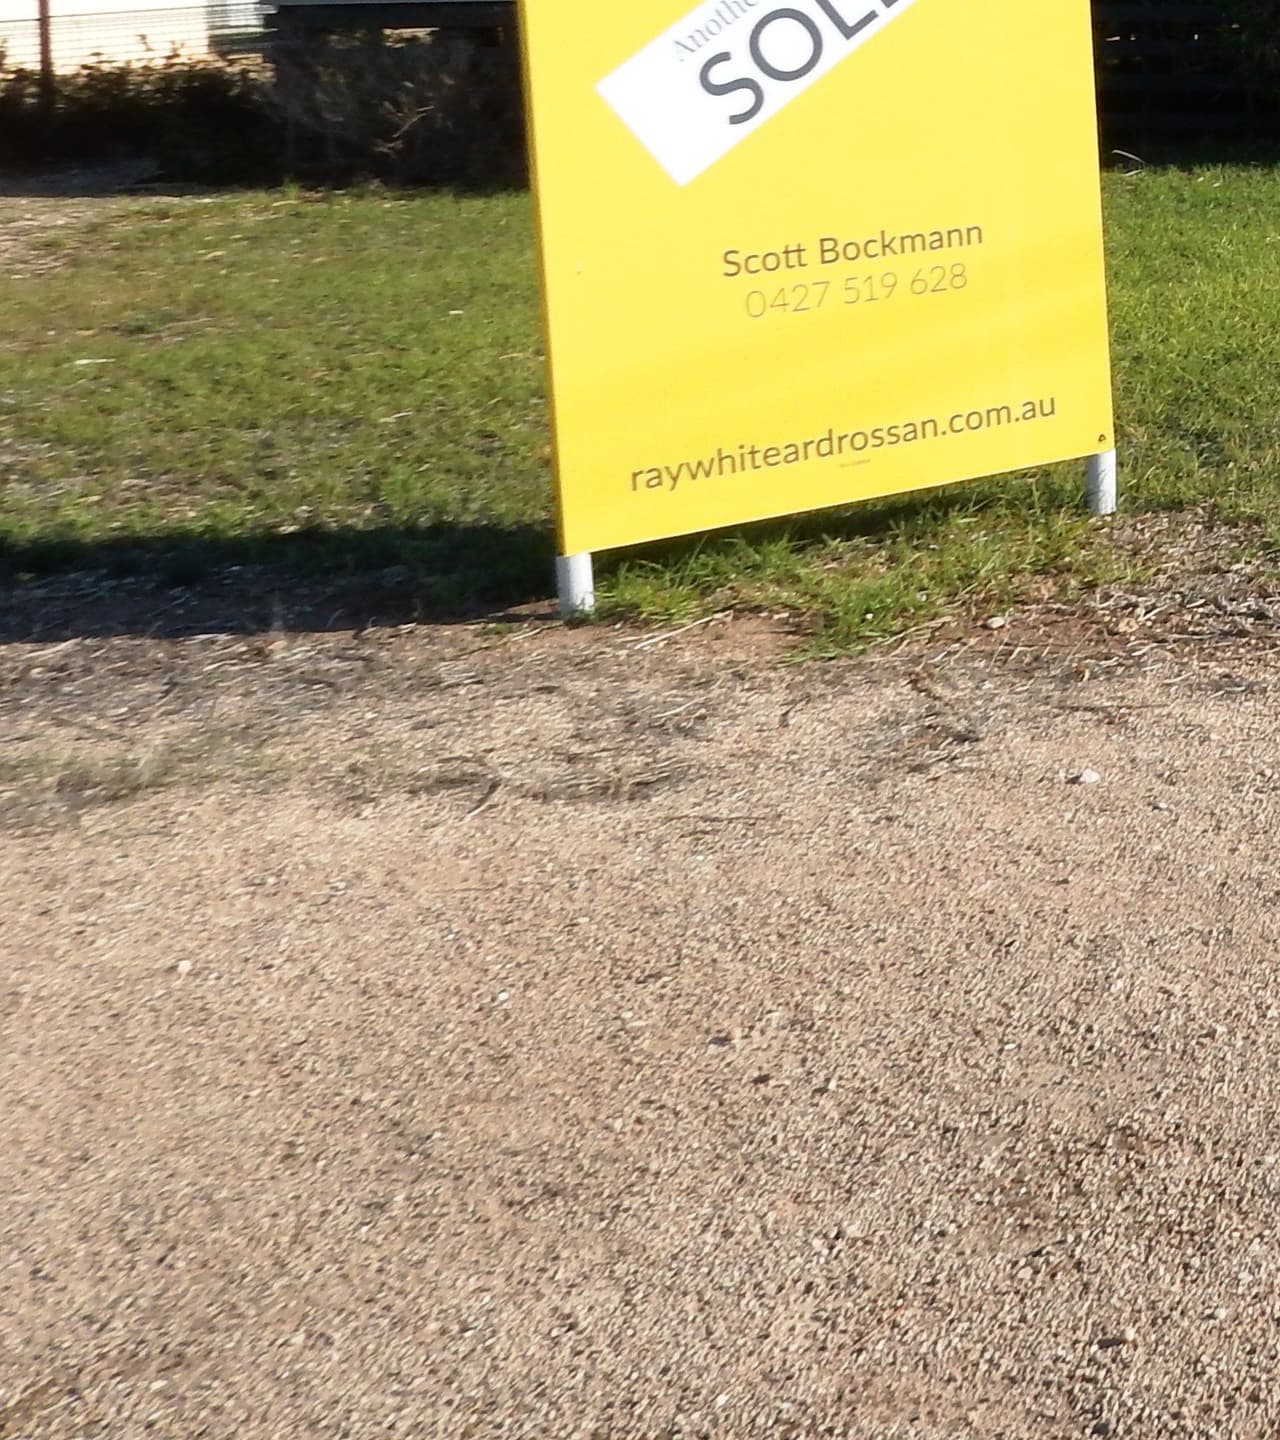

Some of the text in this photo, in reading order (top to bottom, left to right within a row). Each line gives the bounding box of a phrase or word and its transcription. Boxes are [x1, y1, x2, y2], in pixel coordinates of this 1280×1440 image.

[722, 222, 984, 278] Scott Bockmann
[746, 263, 968, 319] 0427 519 628
[629, 395, 1057, 493] raywhiteardrossan.com.au
